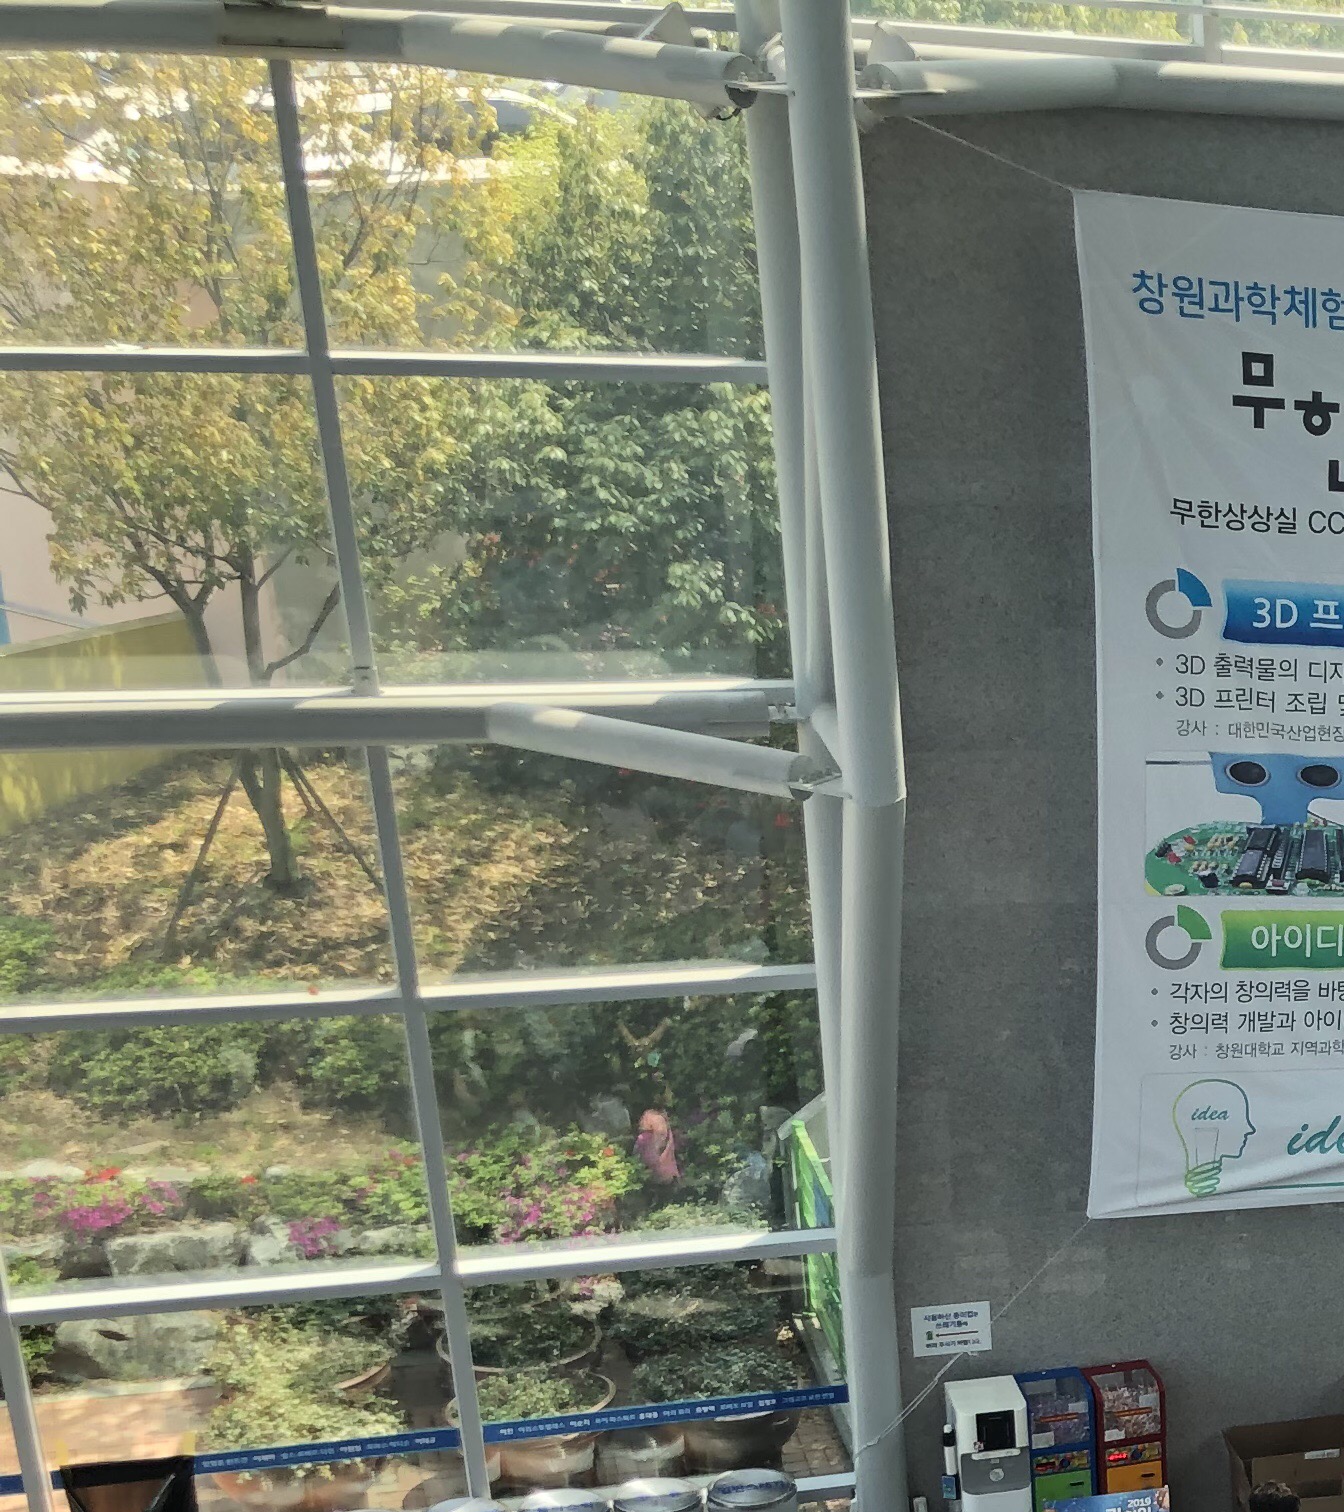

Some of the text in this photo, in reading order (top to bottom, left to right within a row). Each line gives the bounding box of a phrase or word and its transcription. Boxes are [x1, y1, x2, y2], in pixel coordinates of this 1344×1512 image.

[1170, 498, 1297, 535] 무한상상실
[1252, 598, 1297, 630] 3D
[1176, 655, 1205, 676] 3D
[1213, 653, 1298, 682] 출력물의
[1176, 688, 1205, 710] 3D
[1214, 687, 1275, 716] 프린터
[1286, 690, 1327, 716] 조립
[1176, 720, 1207, 738] 강사
[1169, 980, 1229, 1003] 각자의
[1235, 977, 1310, 1002] 창의력을
[1169, 1010, 1229, 1035] 창의력
[1238, 1009, 1297, 1033] 개발과
[1169, 1042, 1197, 1061] 강사
[1215, 1039, 1285, 1059] 창원대학교
[1191, 1105, 1229, 1121] idea
[1128, 1497, 1151, 1508] 2019
